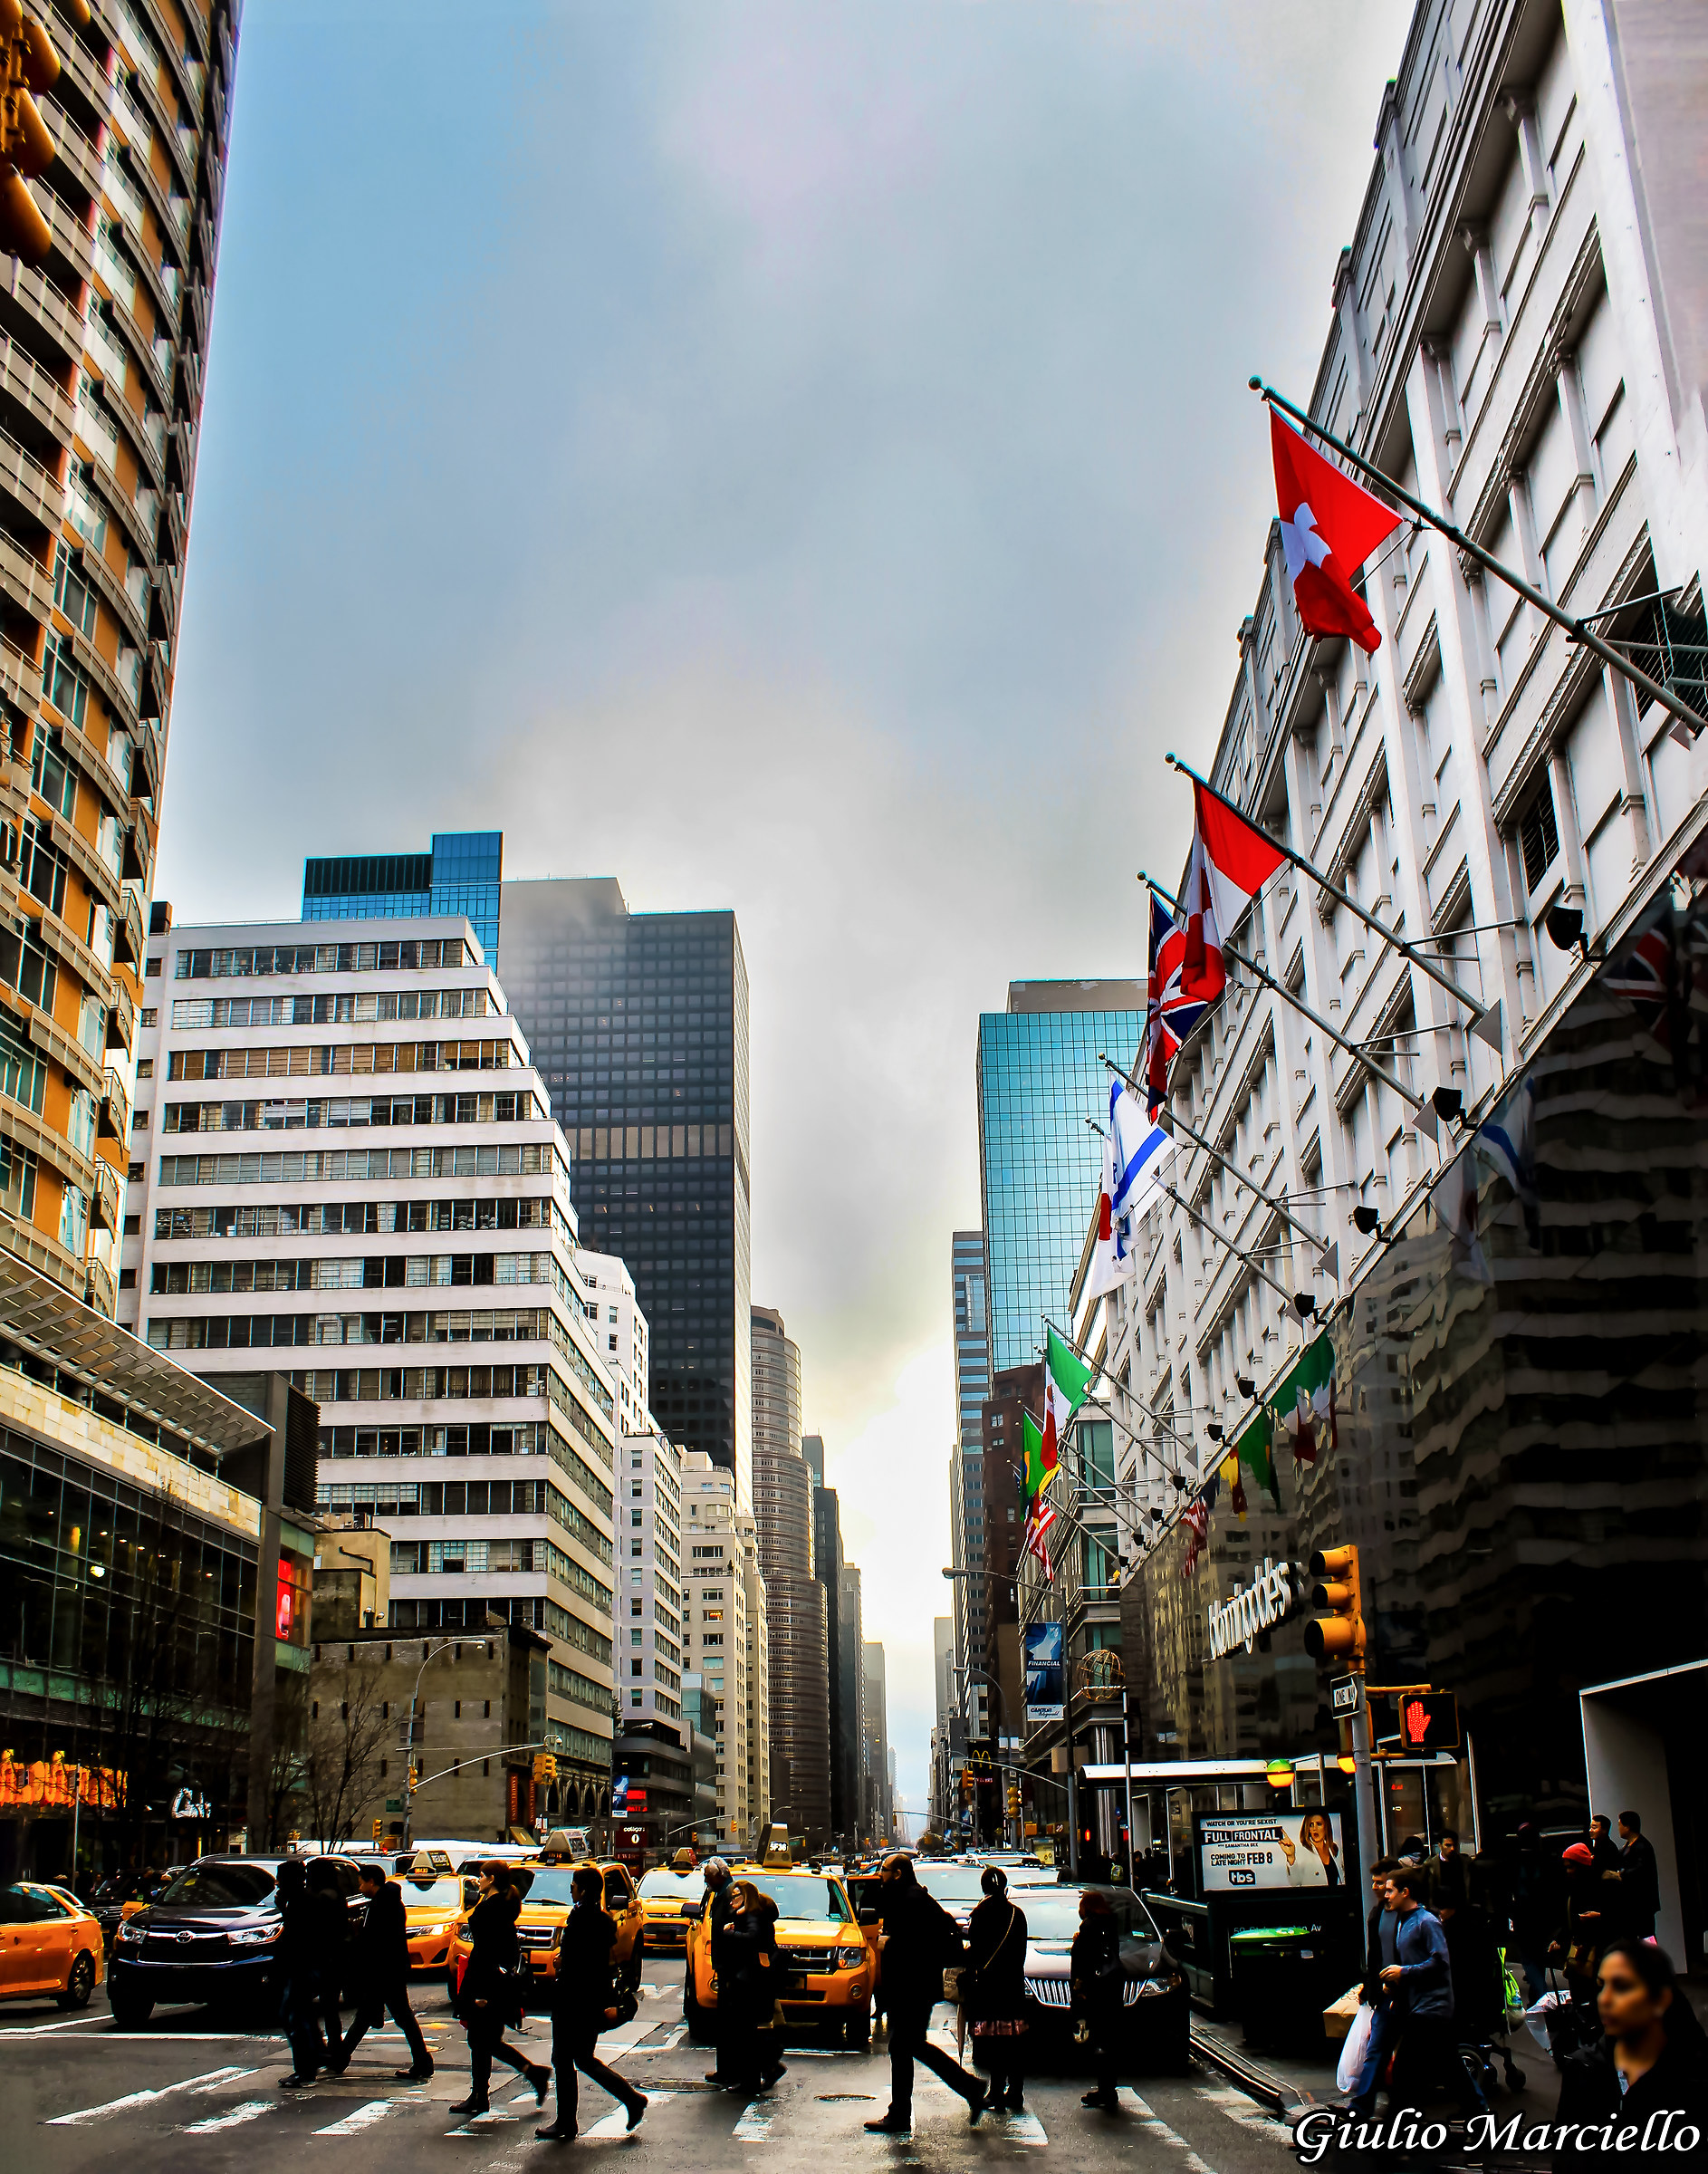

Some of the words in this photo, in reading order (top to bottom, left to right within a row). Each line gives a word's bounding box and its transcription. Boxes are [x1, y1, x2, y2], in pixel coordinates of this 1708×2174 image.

[1204, 1832, 1230, 1843] FULL
[1234, 1829, 1281, 1841] FRONTAL
[770, 1842, 786, 1851] 5F36
[1247, 1852, 1265, 1864] FEB
[1266, 1852, 1273, 1863] 8
[1232, 1872, 1253, 1883] tbs
[1310, 1924, 1321, 1932] Av
